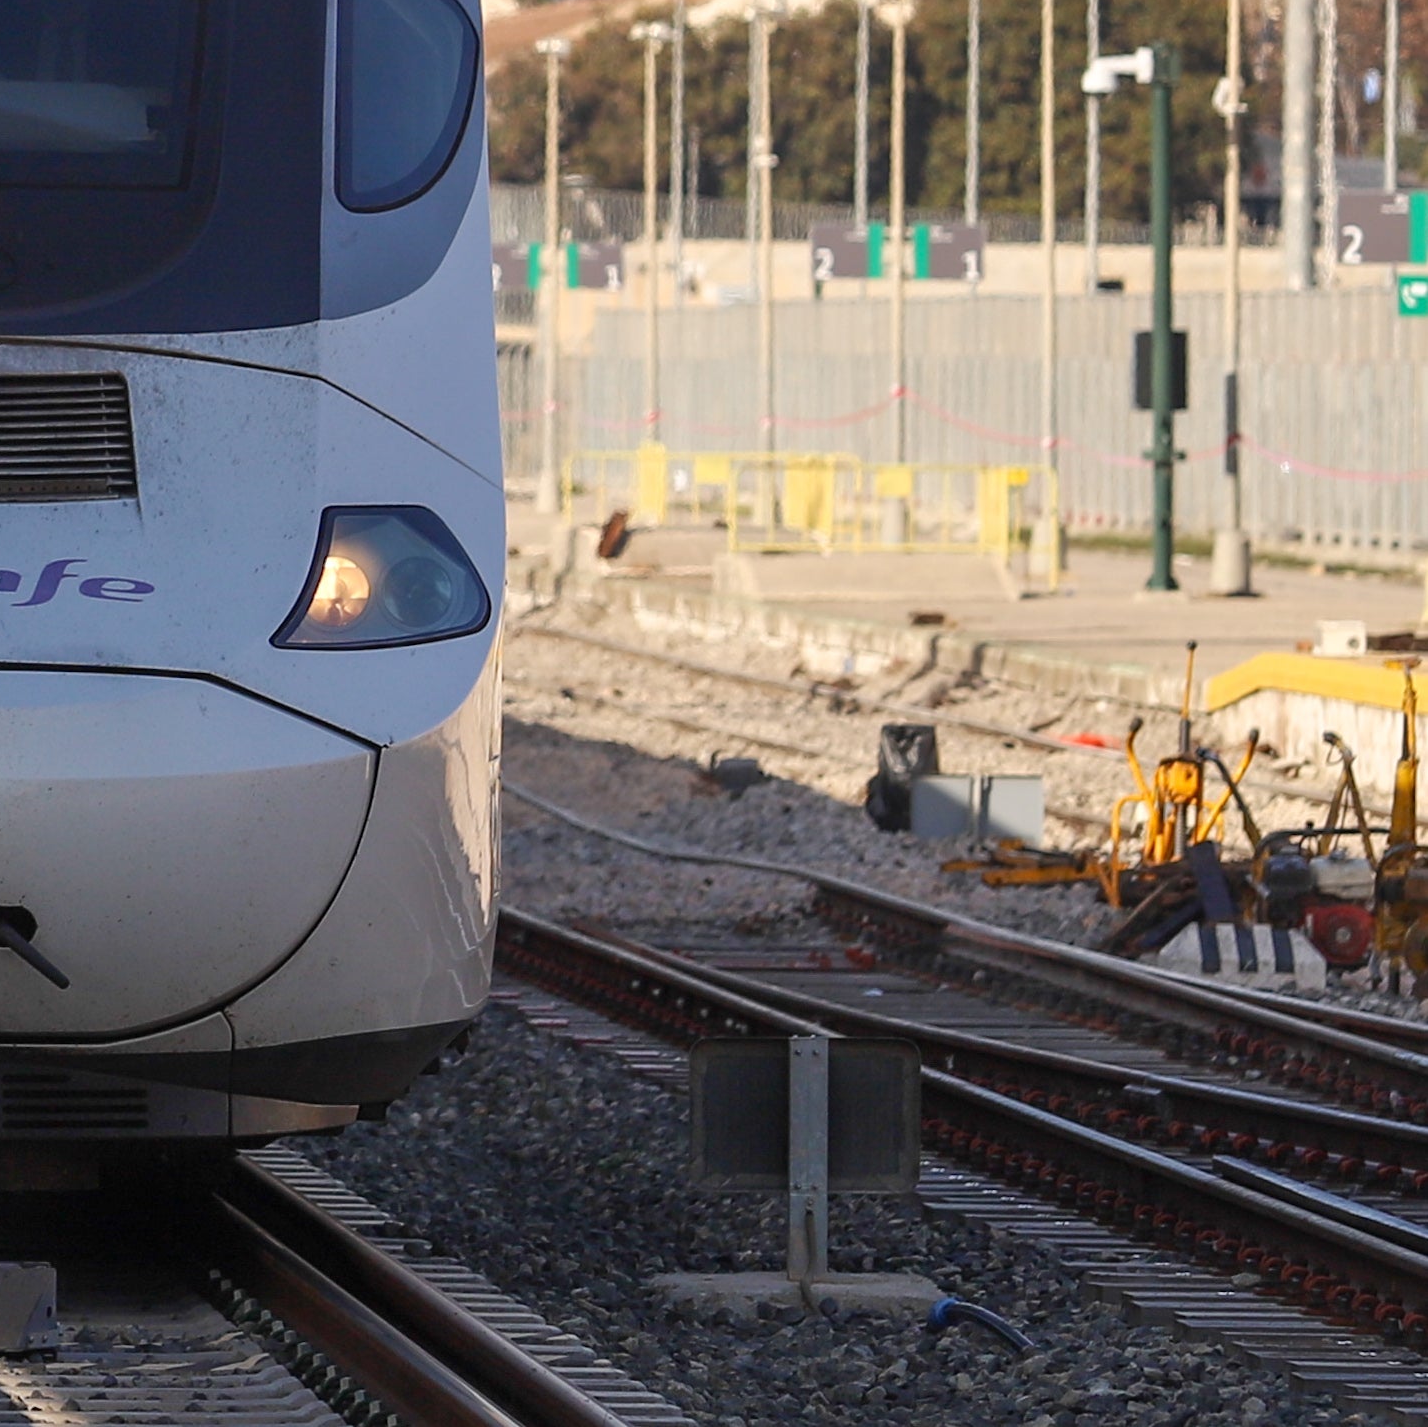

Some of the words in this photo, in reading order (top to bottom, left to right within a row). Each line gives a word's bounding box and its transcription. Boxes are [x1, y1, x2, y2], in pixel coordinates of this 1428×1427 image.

[1342, 224, 1363, 264] 2
[814, 247, 834, 281] 2
[961, 250, 979, 282] 1
